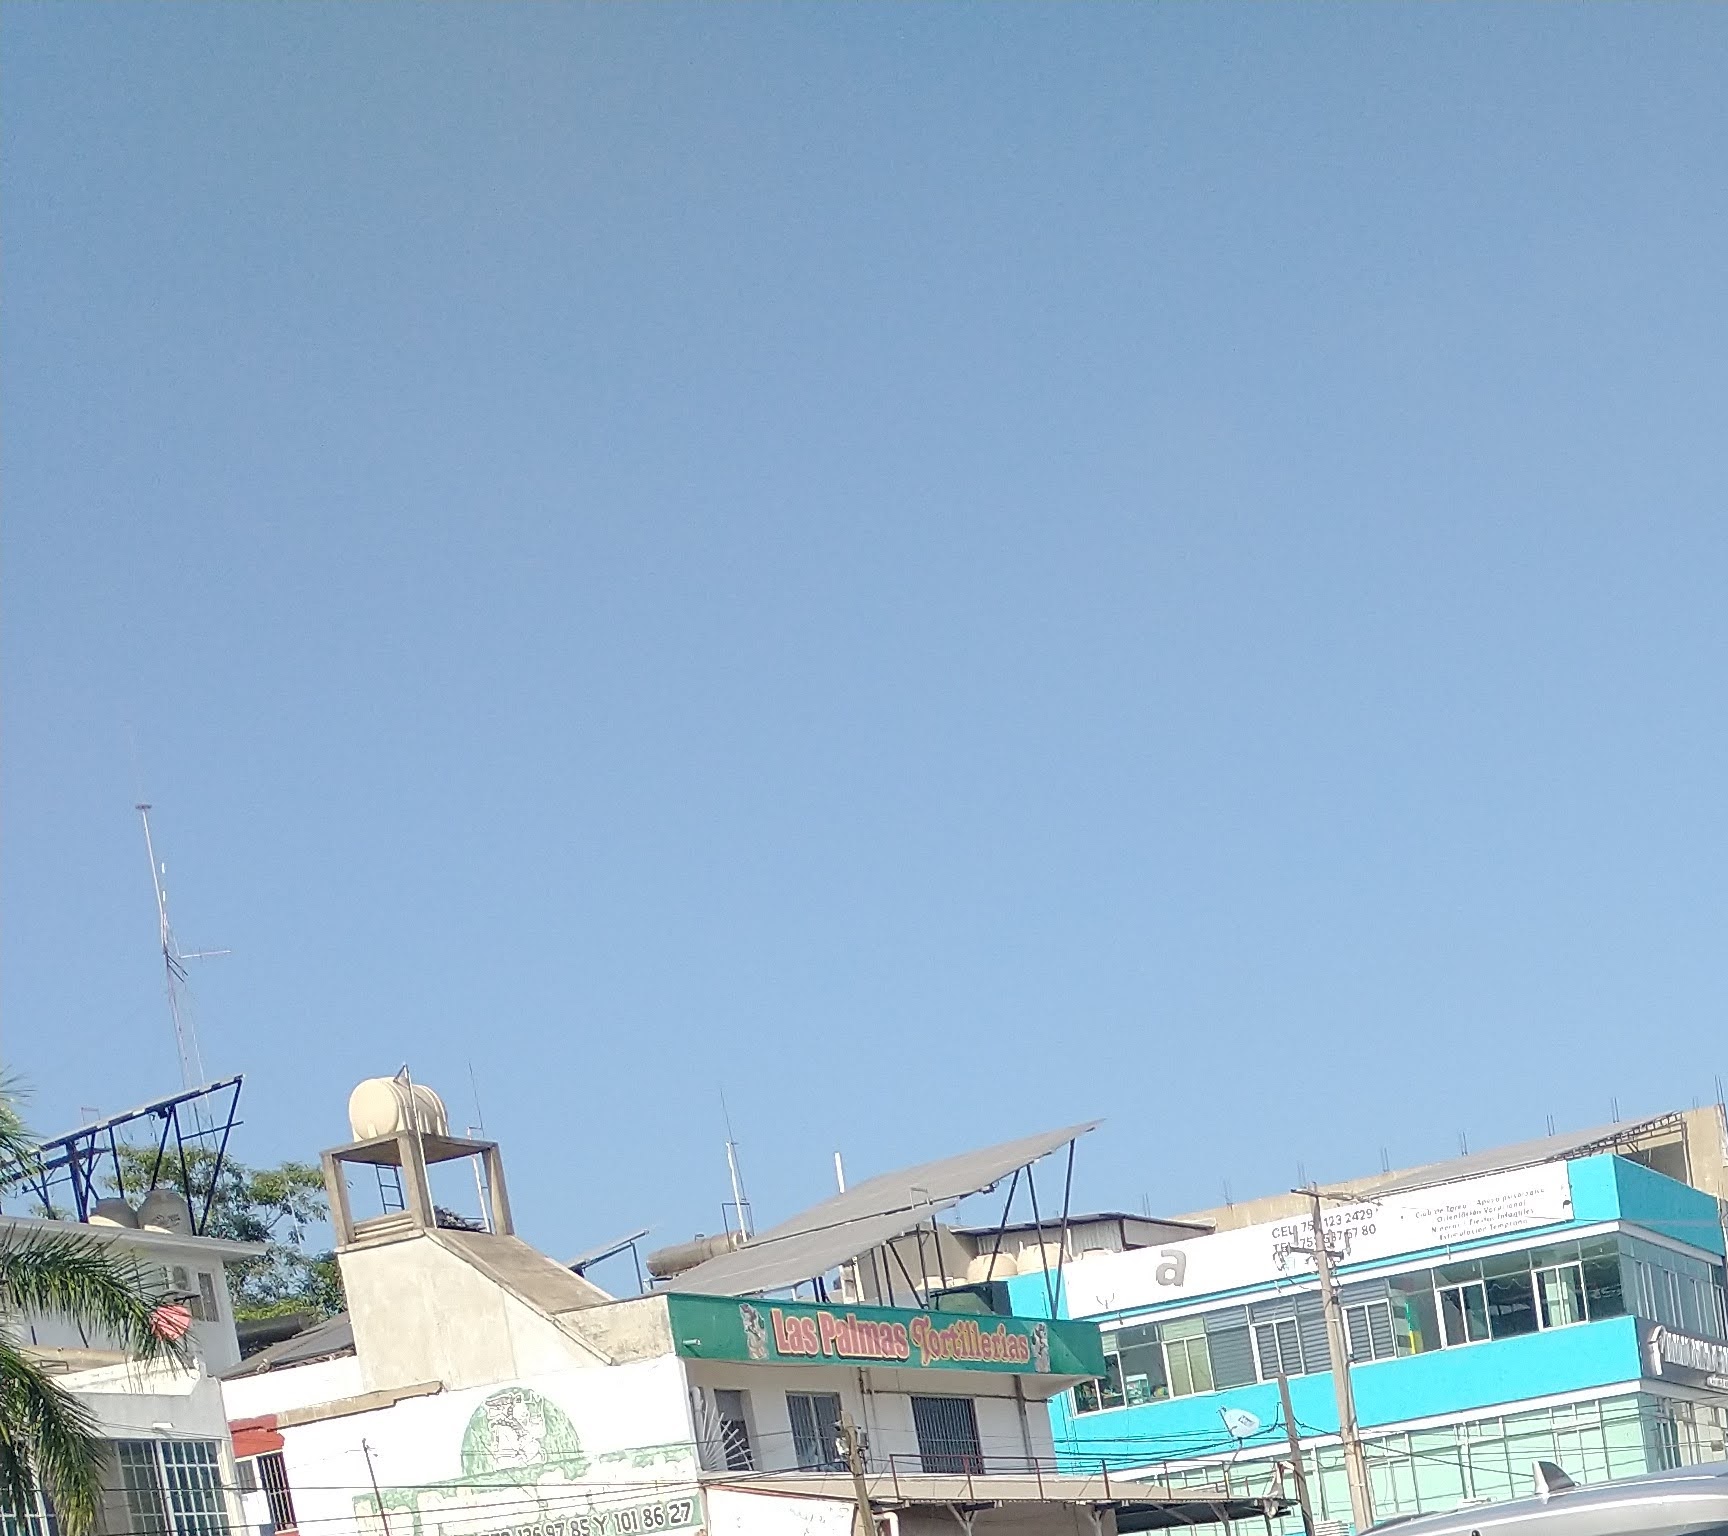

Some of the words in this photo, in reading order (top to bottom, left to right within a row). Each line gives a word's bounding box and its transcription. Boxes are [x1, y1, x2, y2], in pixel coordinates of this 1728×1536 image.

[1323, 1214, 1342, 1228] 123
[1361, 1223, 1377, 1237] 80
[1156, 1249, 1187, 1287] a
[770, 1308, 818, 1356] Las
[816, 1310, 911, 1362] Palmas
[594, 1515, 609, 1536] Y
[613, 1510, 638, 1533] 101
[642, 1505, 664, 1529] 86
[669, 1501, 692, 1525] 27
